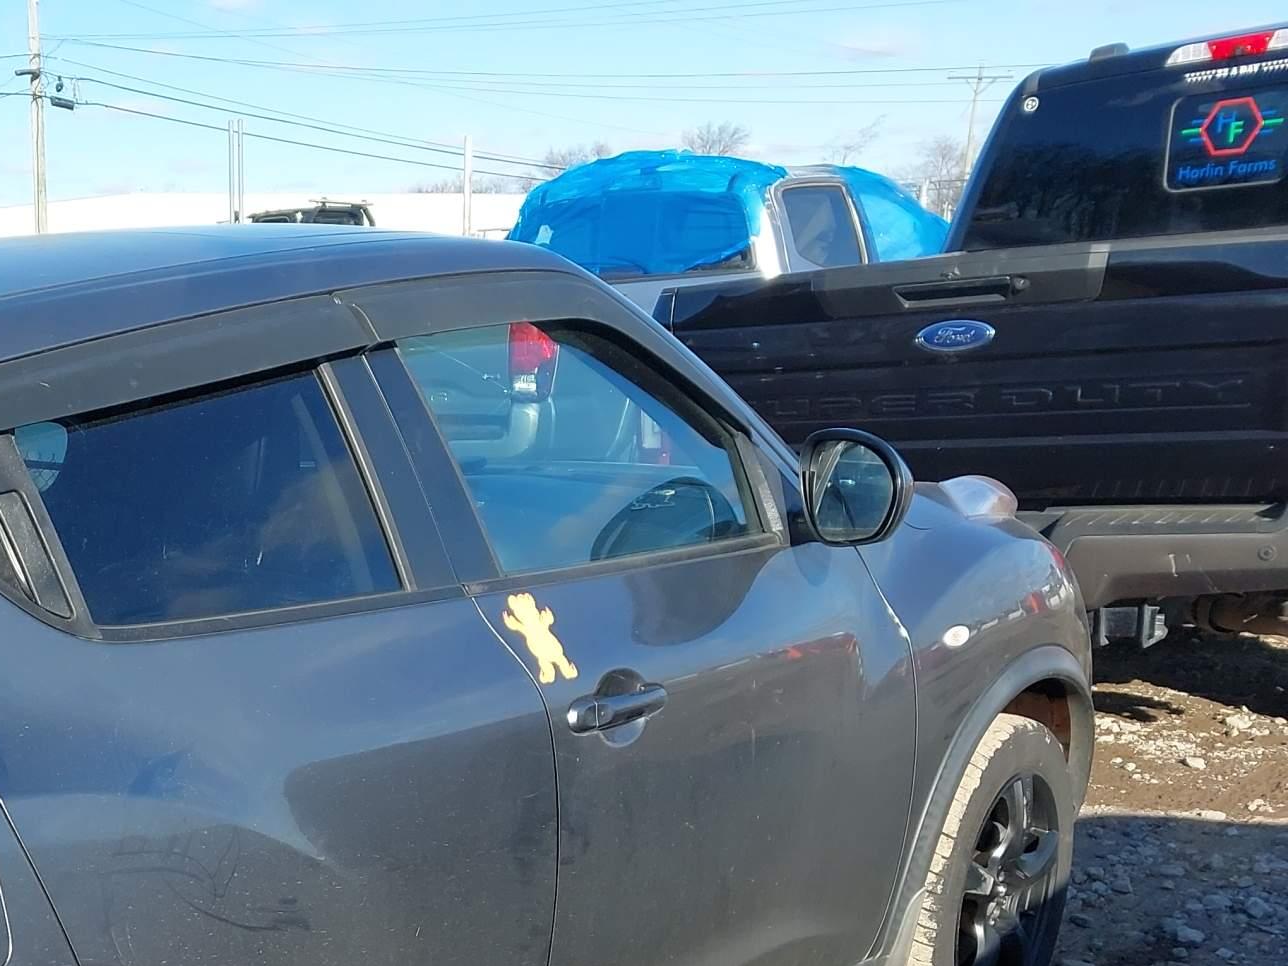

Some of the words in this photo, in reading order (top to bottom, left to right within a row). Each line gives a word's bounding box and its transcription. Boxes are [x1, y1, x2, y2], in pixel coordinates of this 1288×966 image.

[1229, 158, 1277, 175] Farms
[933, 326, 977, 344] Ford
[999, 378, 1243, 406] DUTY
